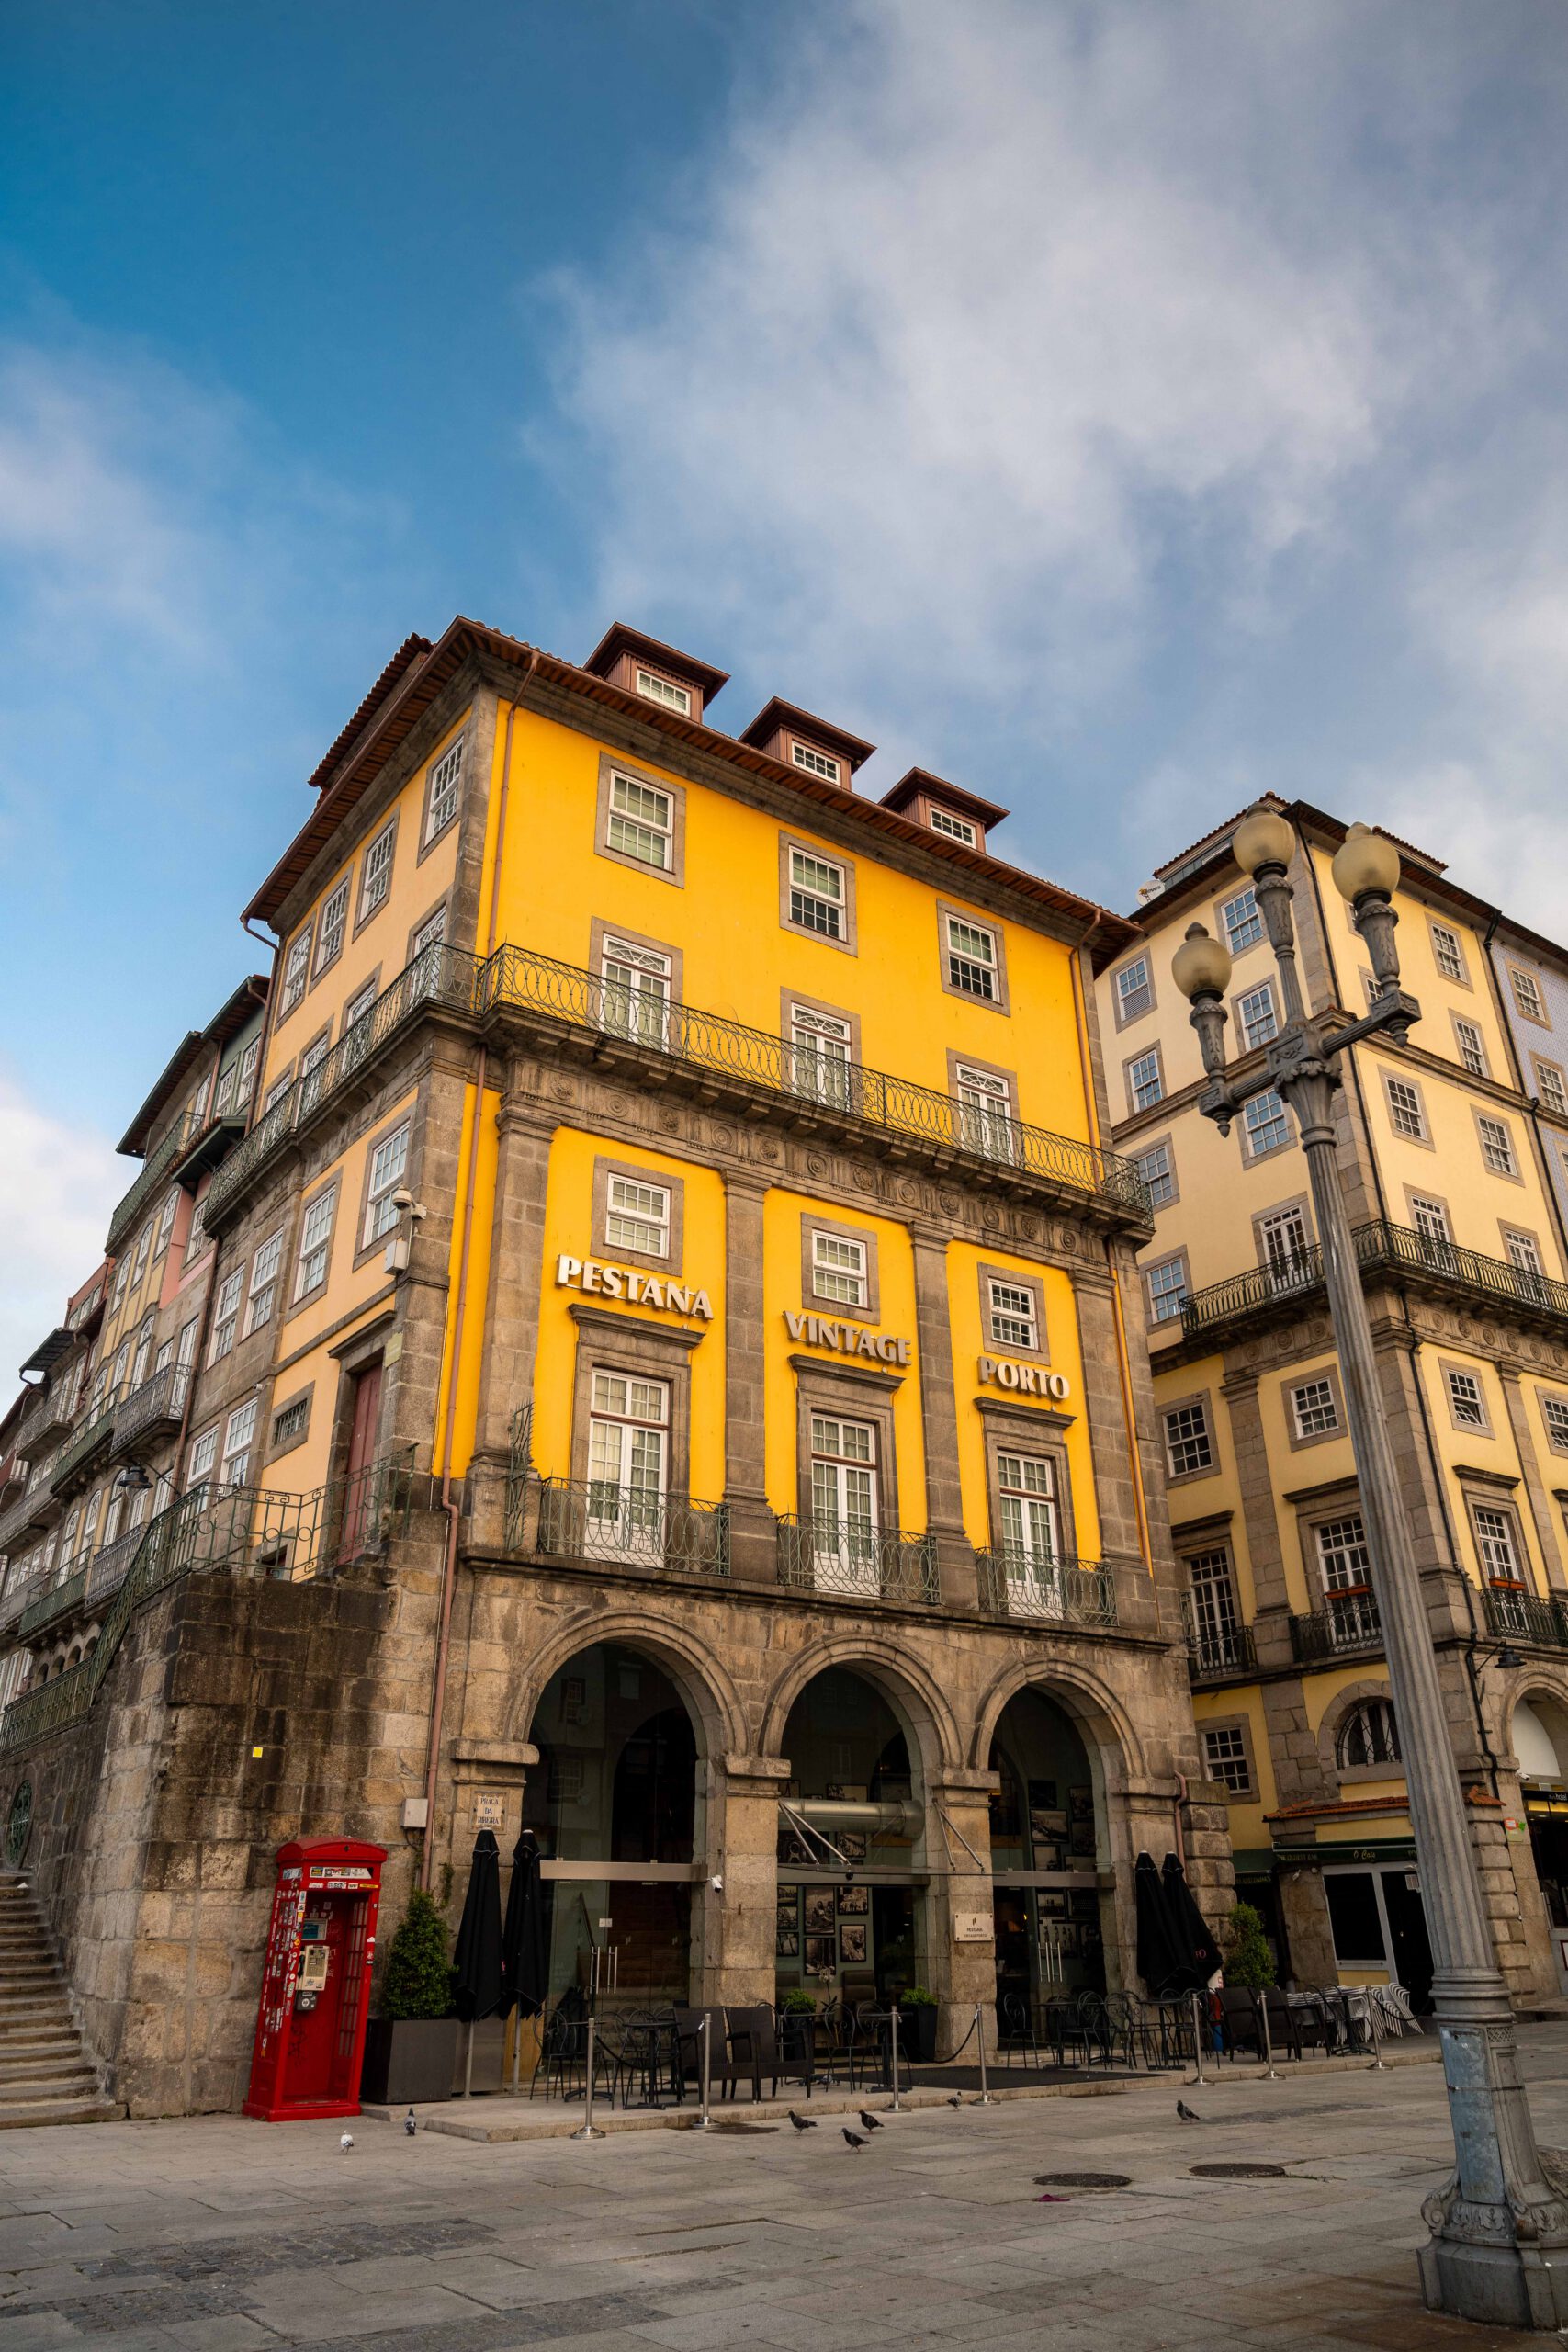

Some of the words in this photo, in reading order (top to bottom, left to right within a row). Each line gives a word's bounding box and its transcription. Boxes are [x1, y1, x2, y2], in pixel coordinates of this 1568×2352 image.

[556, 1253, 714, 1319] PESTANA
[782, 1309, 912, 1366] VINTAGE
[977, 1355, 1070, 1399] PORTO
